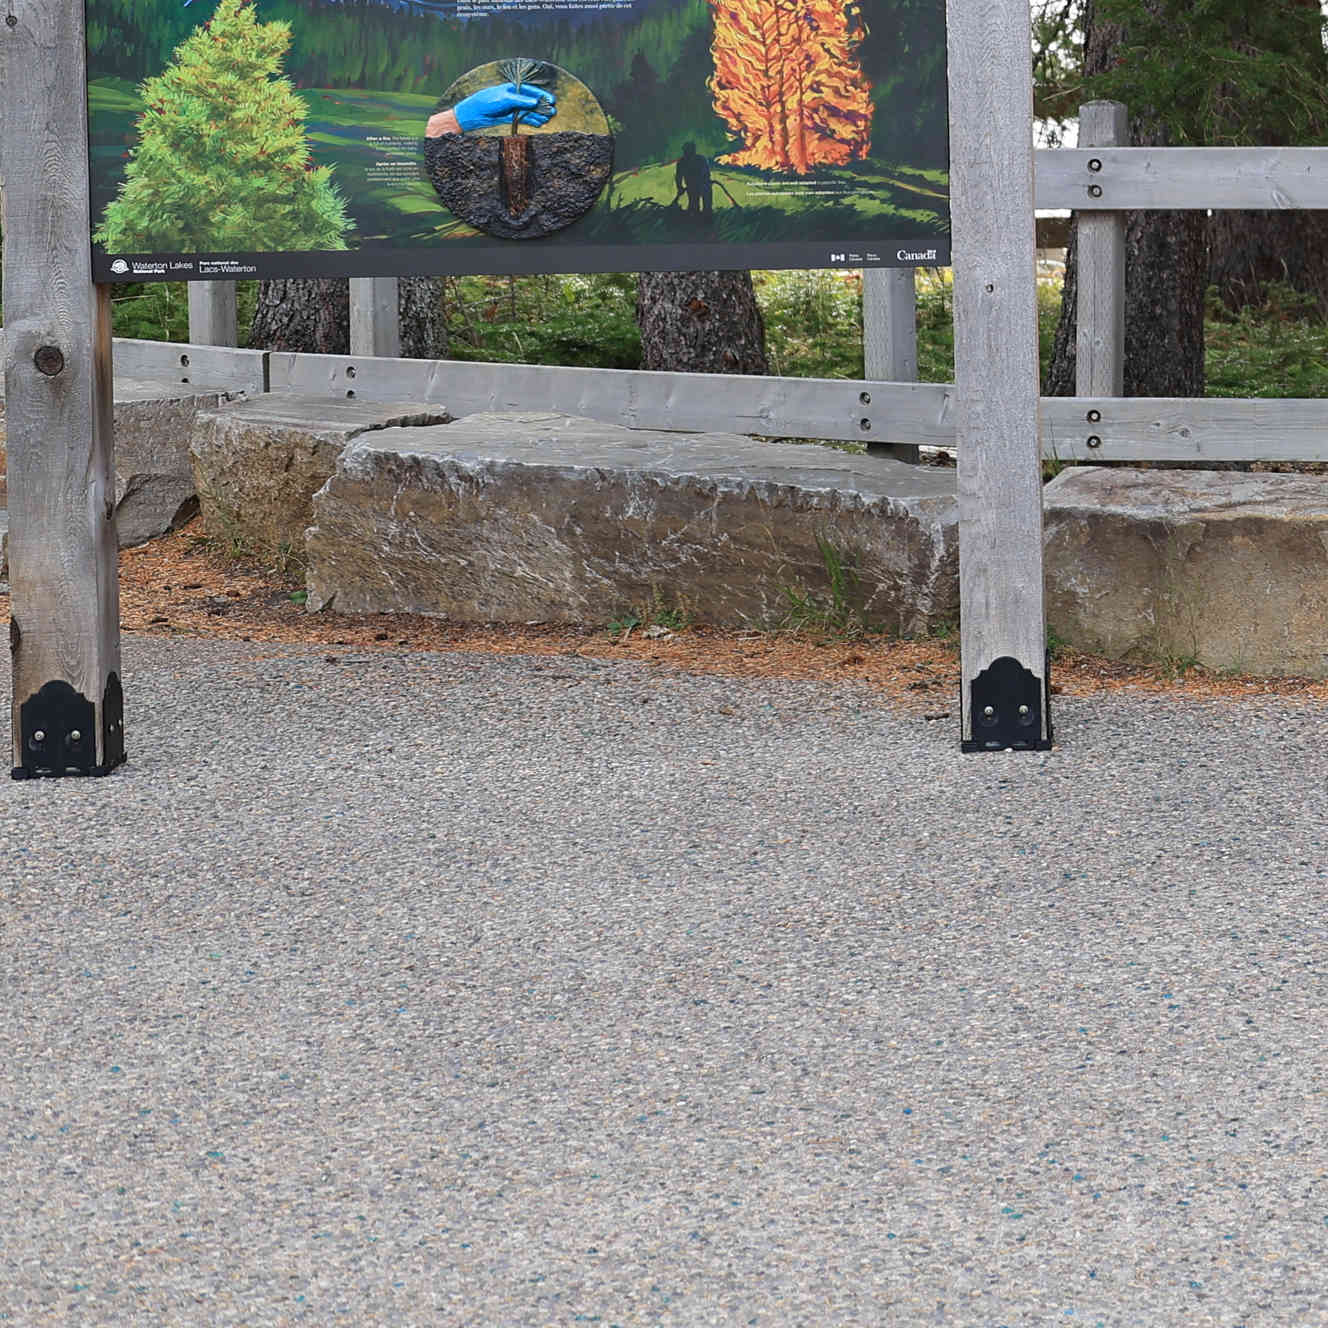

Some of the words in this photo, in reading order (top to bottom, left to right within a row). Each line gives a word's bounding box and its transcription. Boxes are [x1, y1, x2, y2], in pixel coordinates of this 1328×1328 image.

[896, 249, 936, 260] Canada
[132, 262, 168, 270] Waterton
[170, 261, 194, 270] Lakes
[200, 265, 256, 273] Lacs-Waterton
